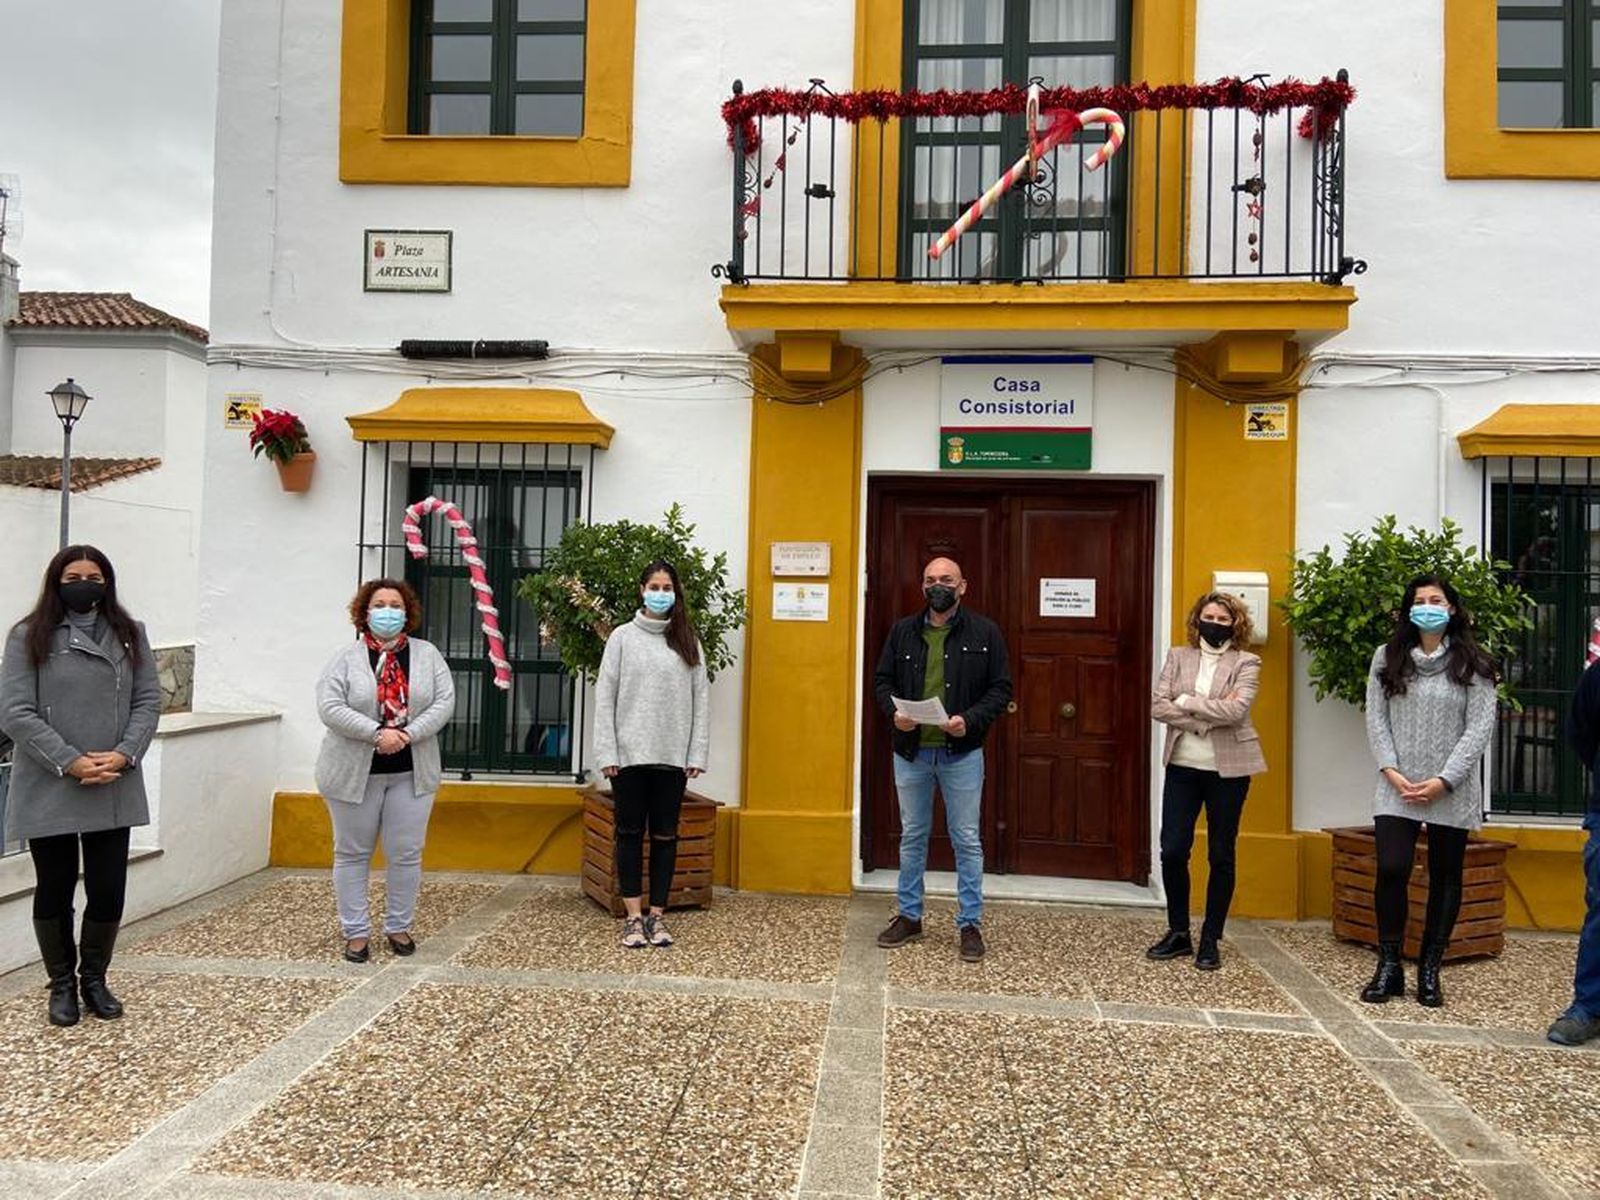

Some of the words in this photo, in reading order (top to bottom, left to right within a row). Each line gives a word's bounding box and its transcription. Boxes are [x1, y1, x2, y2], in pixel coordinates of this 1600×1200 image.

[393, 243, 424, 256] Plaza
[375, 266, 438, 277] ARTESANIA
[993, 377, 1041, 392] Casa
[959, 399, 1075, 414] Consistorial
